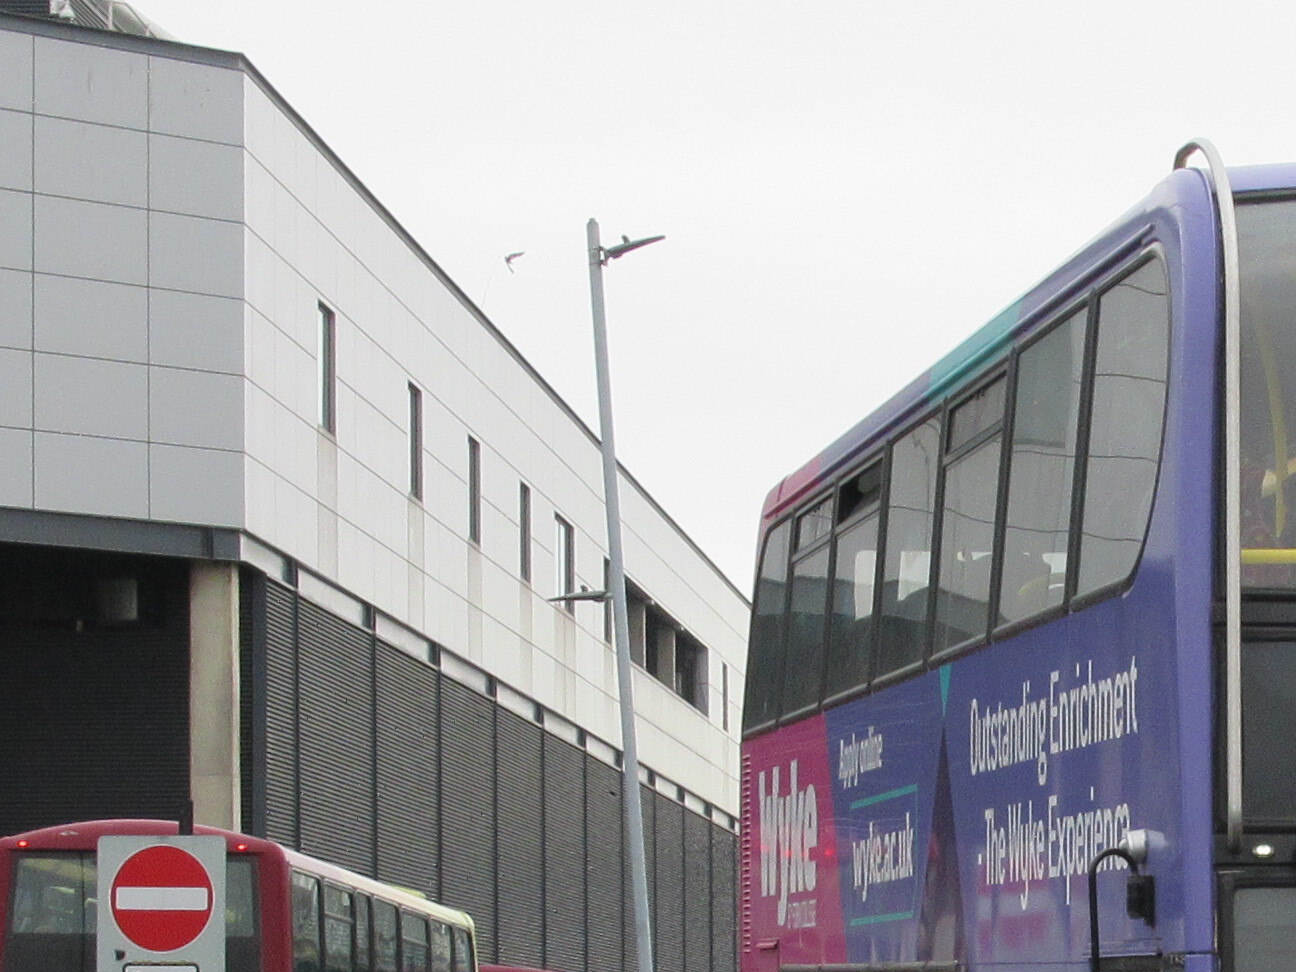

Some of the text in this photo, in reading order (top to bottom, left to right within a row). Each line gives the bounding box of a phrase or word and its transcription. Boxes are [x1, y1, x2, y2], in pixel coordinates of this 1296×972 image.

[969, 655, 1138, 786] Outstanding Enrichment
[758, 758, 818, 927] Wyke
[853, 812, 914, 902] wyke.ac.uk
[985, 808, 1006, 886] The
[1008, 801, 1046, 910] Wyke
